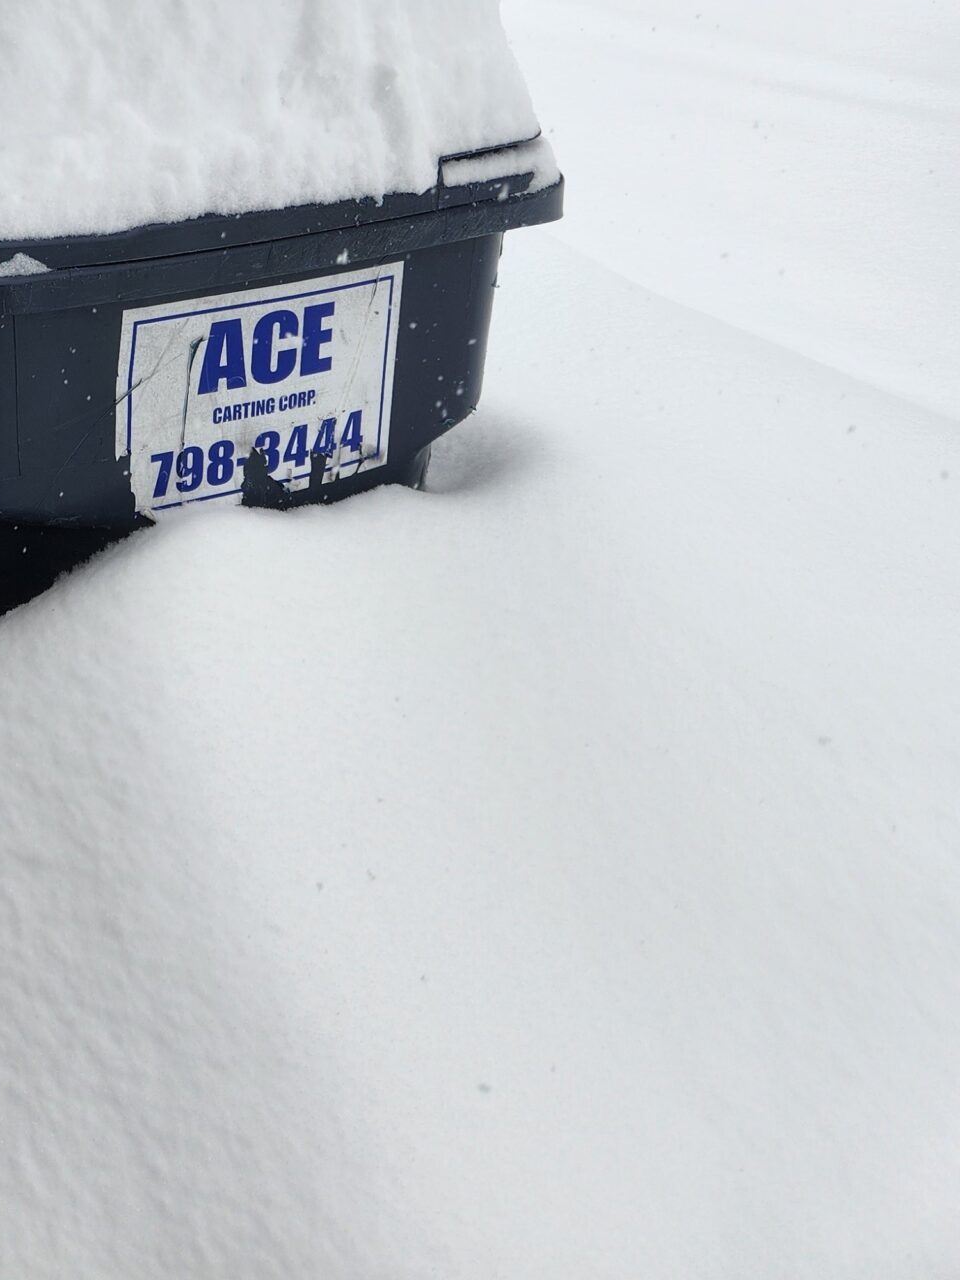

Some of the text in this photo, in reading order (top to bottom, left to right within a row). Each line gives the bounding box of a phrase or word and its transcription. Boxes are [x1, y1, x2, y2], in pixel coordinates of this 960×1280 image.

[197, 301, 336, 396] ACE
[212, 389, 317, 425] CARTING CORP.
[150, 409, 364, 499] 798-3444
